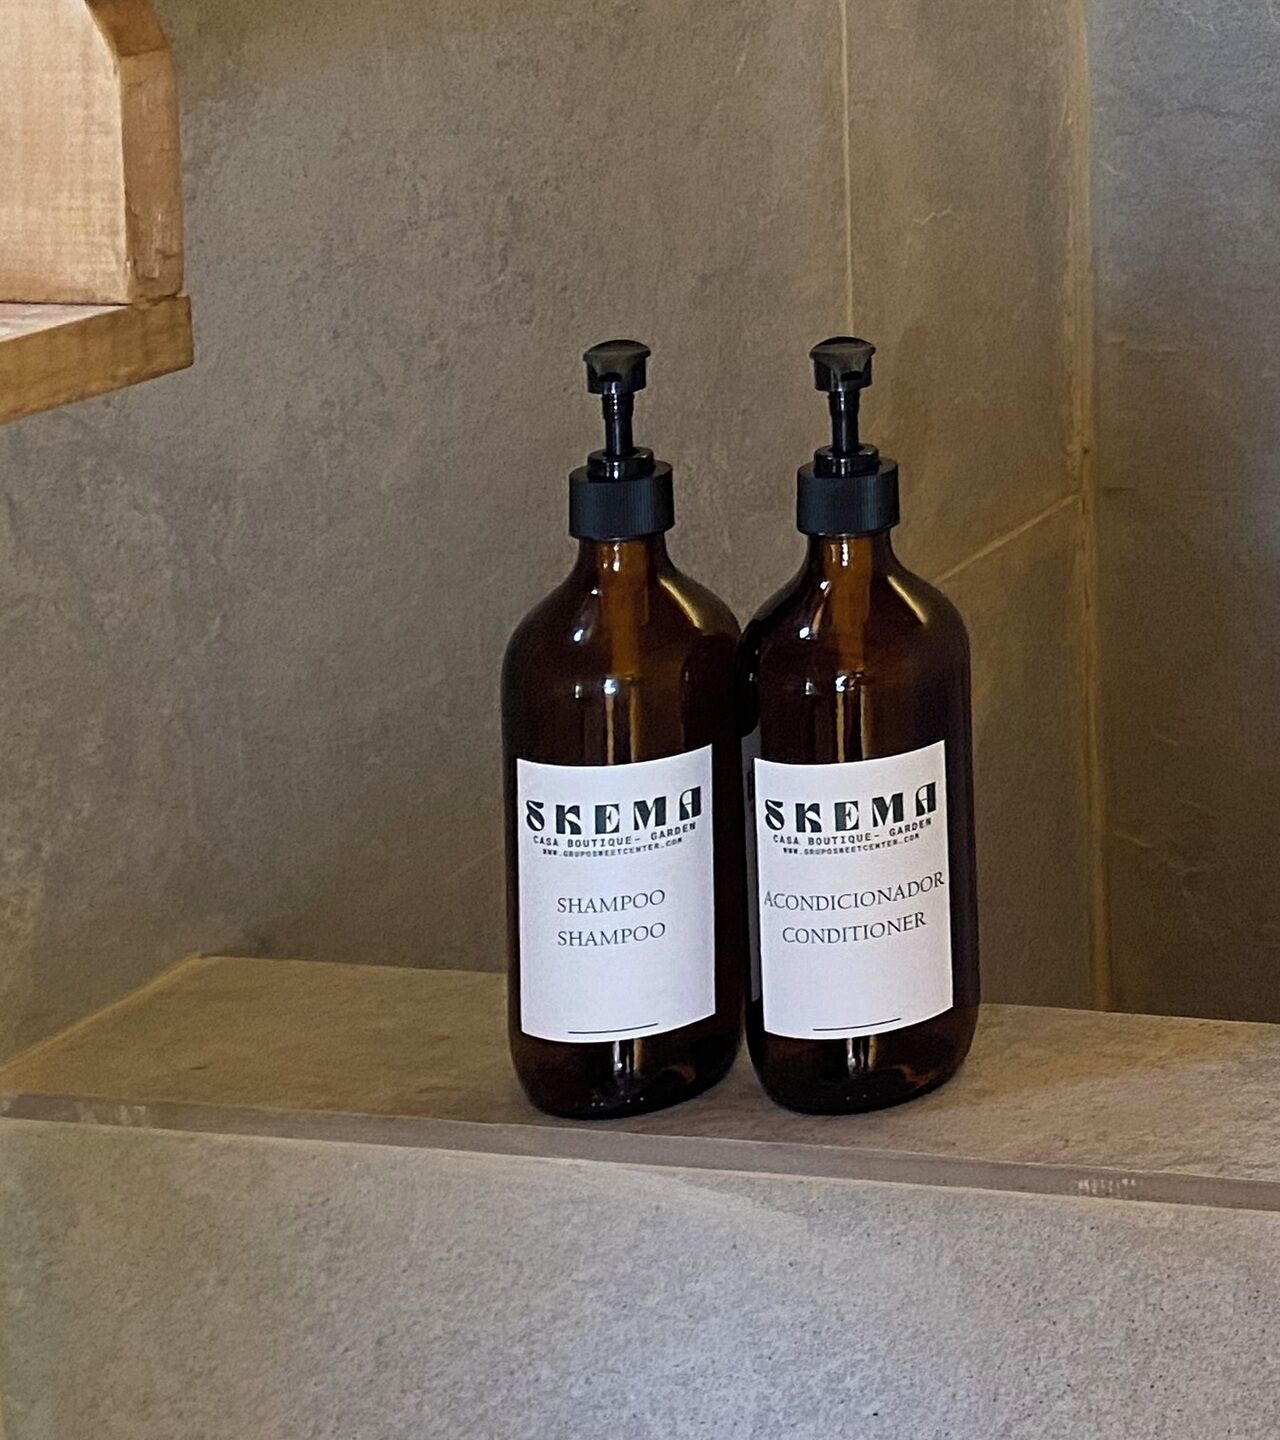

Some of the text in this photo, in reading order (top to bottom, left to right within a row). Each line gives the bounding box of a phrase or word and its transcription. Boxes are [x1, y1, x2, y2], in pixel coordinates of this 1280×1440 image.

[526, 786, 702, 835] SKEMA
[764, 781, 937, 833] SKEMA
[533, 835, 559, 847] CASA
[650, 821, 697, 841] GARDEN
[773, 834, 800, 845] CASA
[888, 817, 932, 837] GARDEN
[557, 889, 666, 914] SHAMPOO
[764, 871, 945, 911] ACONDICIONADOR
[557, 922, 666, 947] SHAMPOO
[782, 911, 927, 944] CONDITIONER
